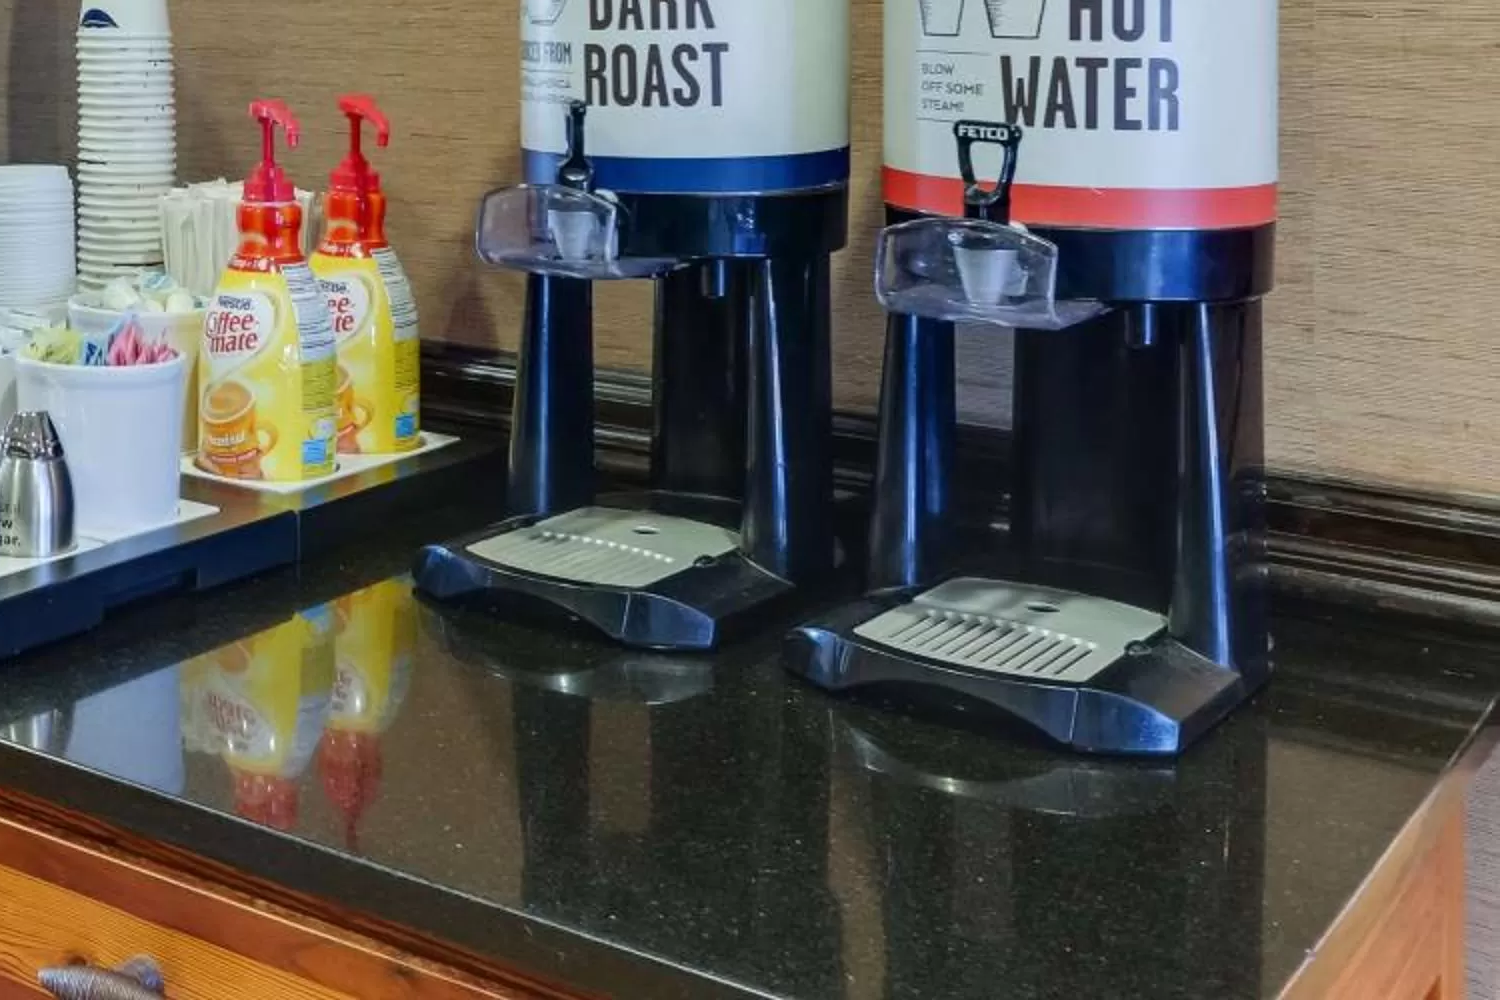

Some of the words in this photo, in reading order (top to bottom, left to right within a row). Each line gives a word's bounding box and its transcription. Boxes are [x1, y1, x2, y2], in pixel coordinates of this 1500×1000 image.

[583, 42, 730, 108] ROAST
[921, 63, 955, 75] BLOW
[921, 81, 943, 92] OFF
[945, 82, 984, 96] SOME
[1000, 55, 1180, 131] WATER
[958, 125, 1009, 141] FETCO
[210, 332, 258, 353] mate
